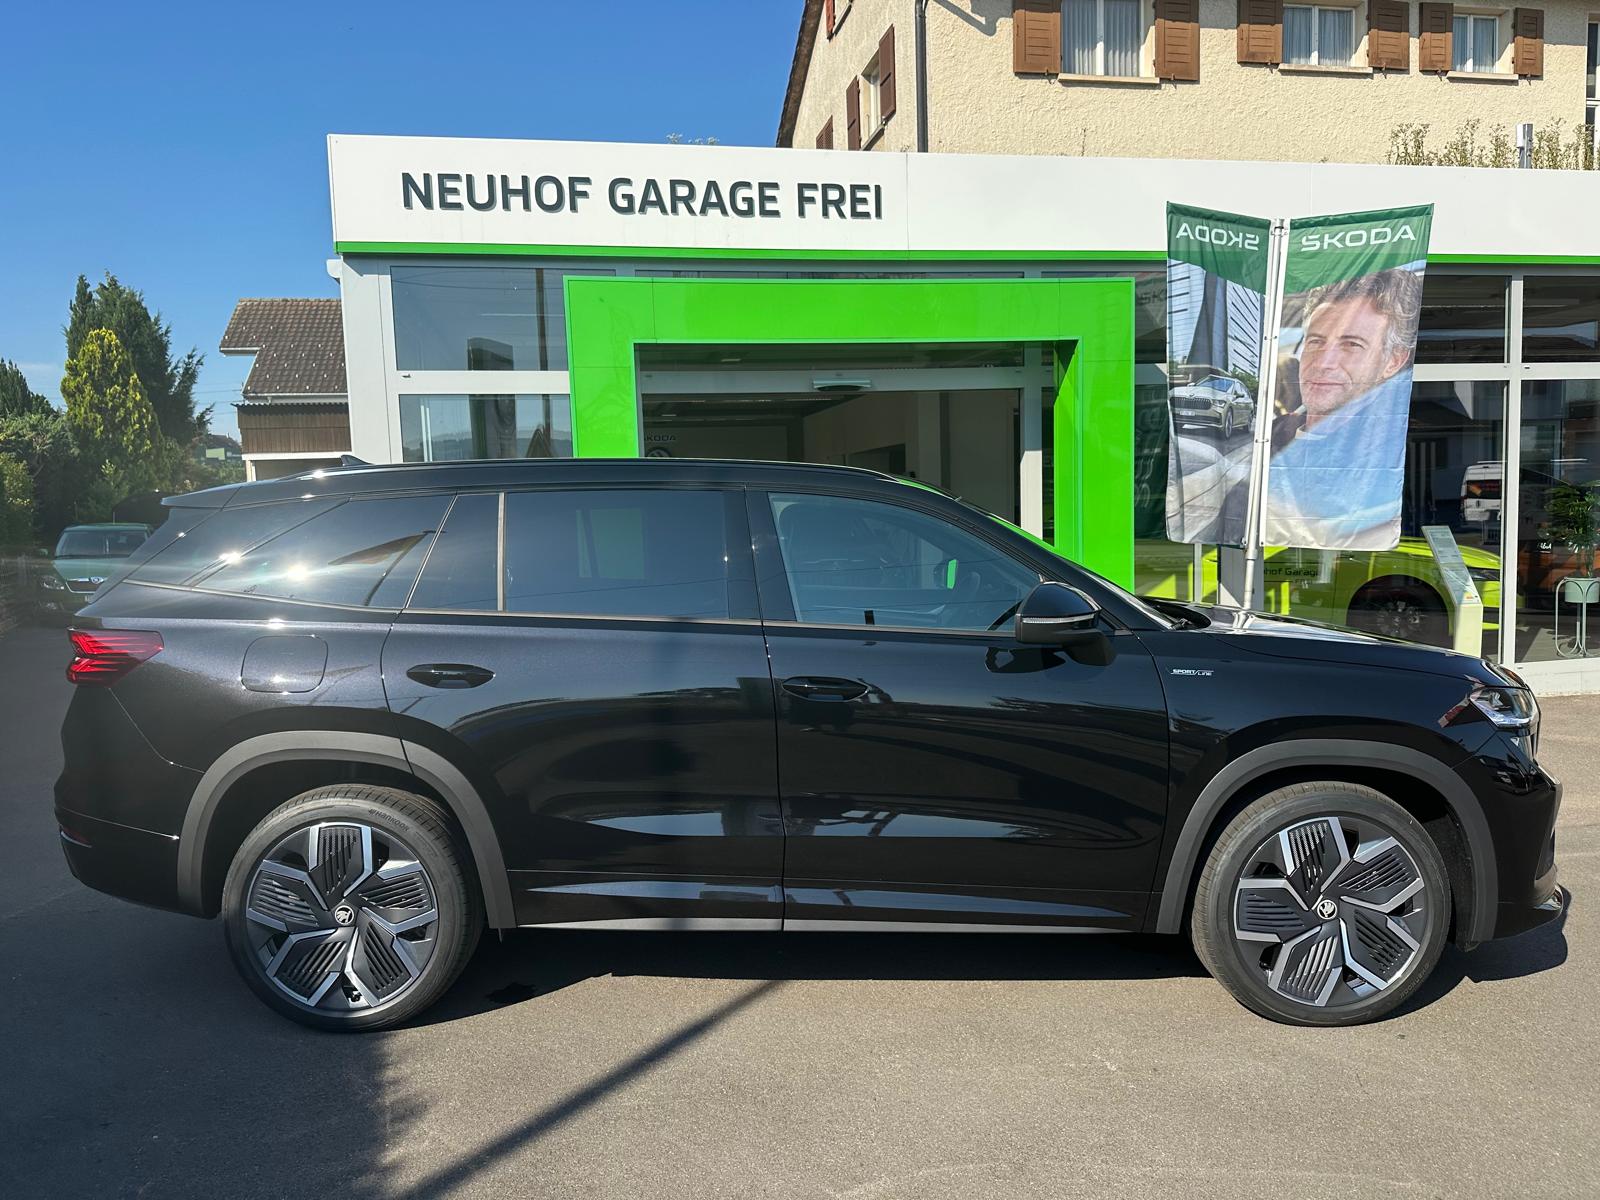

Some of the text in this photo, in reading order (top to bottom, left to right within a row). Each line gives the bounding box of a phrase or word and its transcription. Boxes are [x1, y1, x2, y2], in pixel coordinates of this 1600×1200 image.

[402, 172, 882, 219] NEUHOF GARAGE FREI
